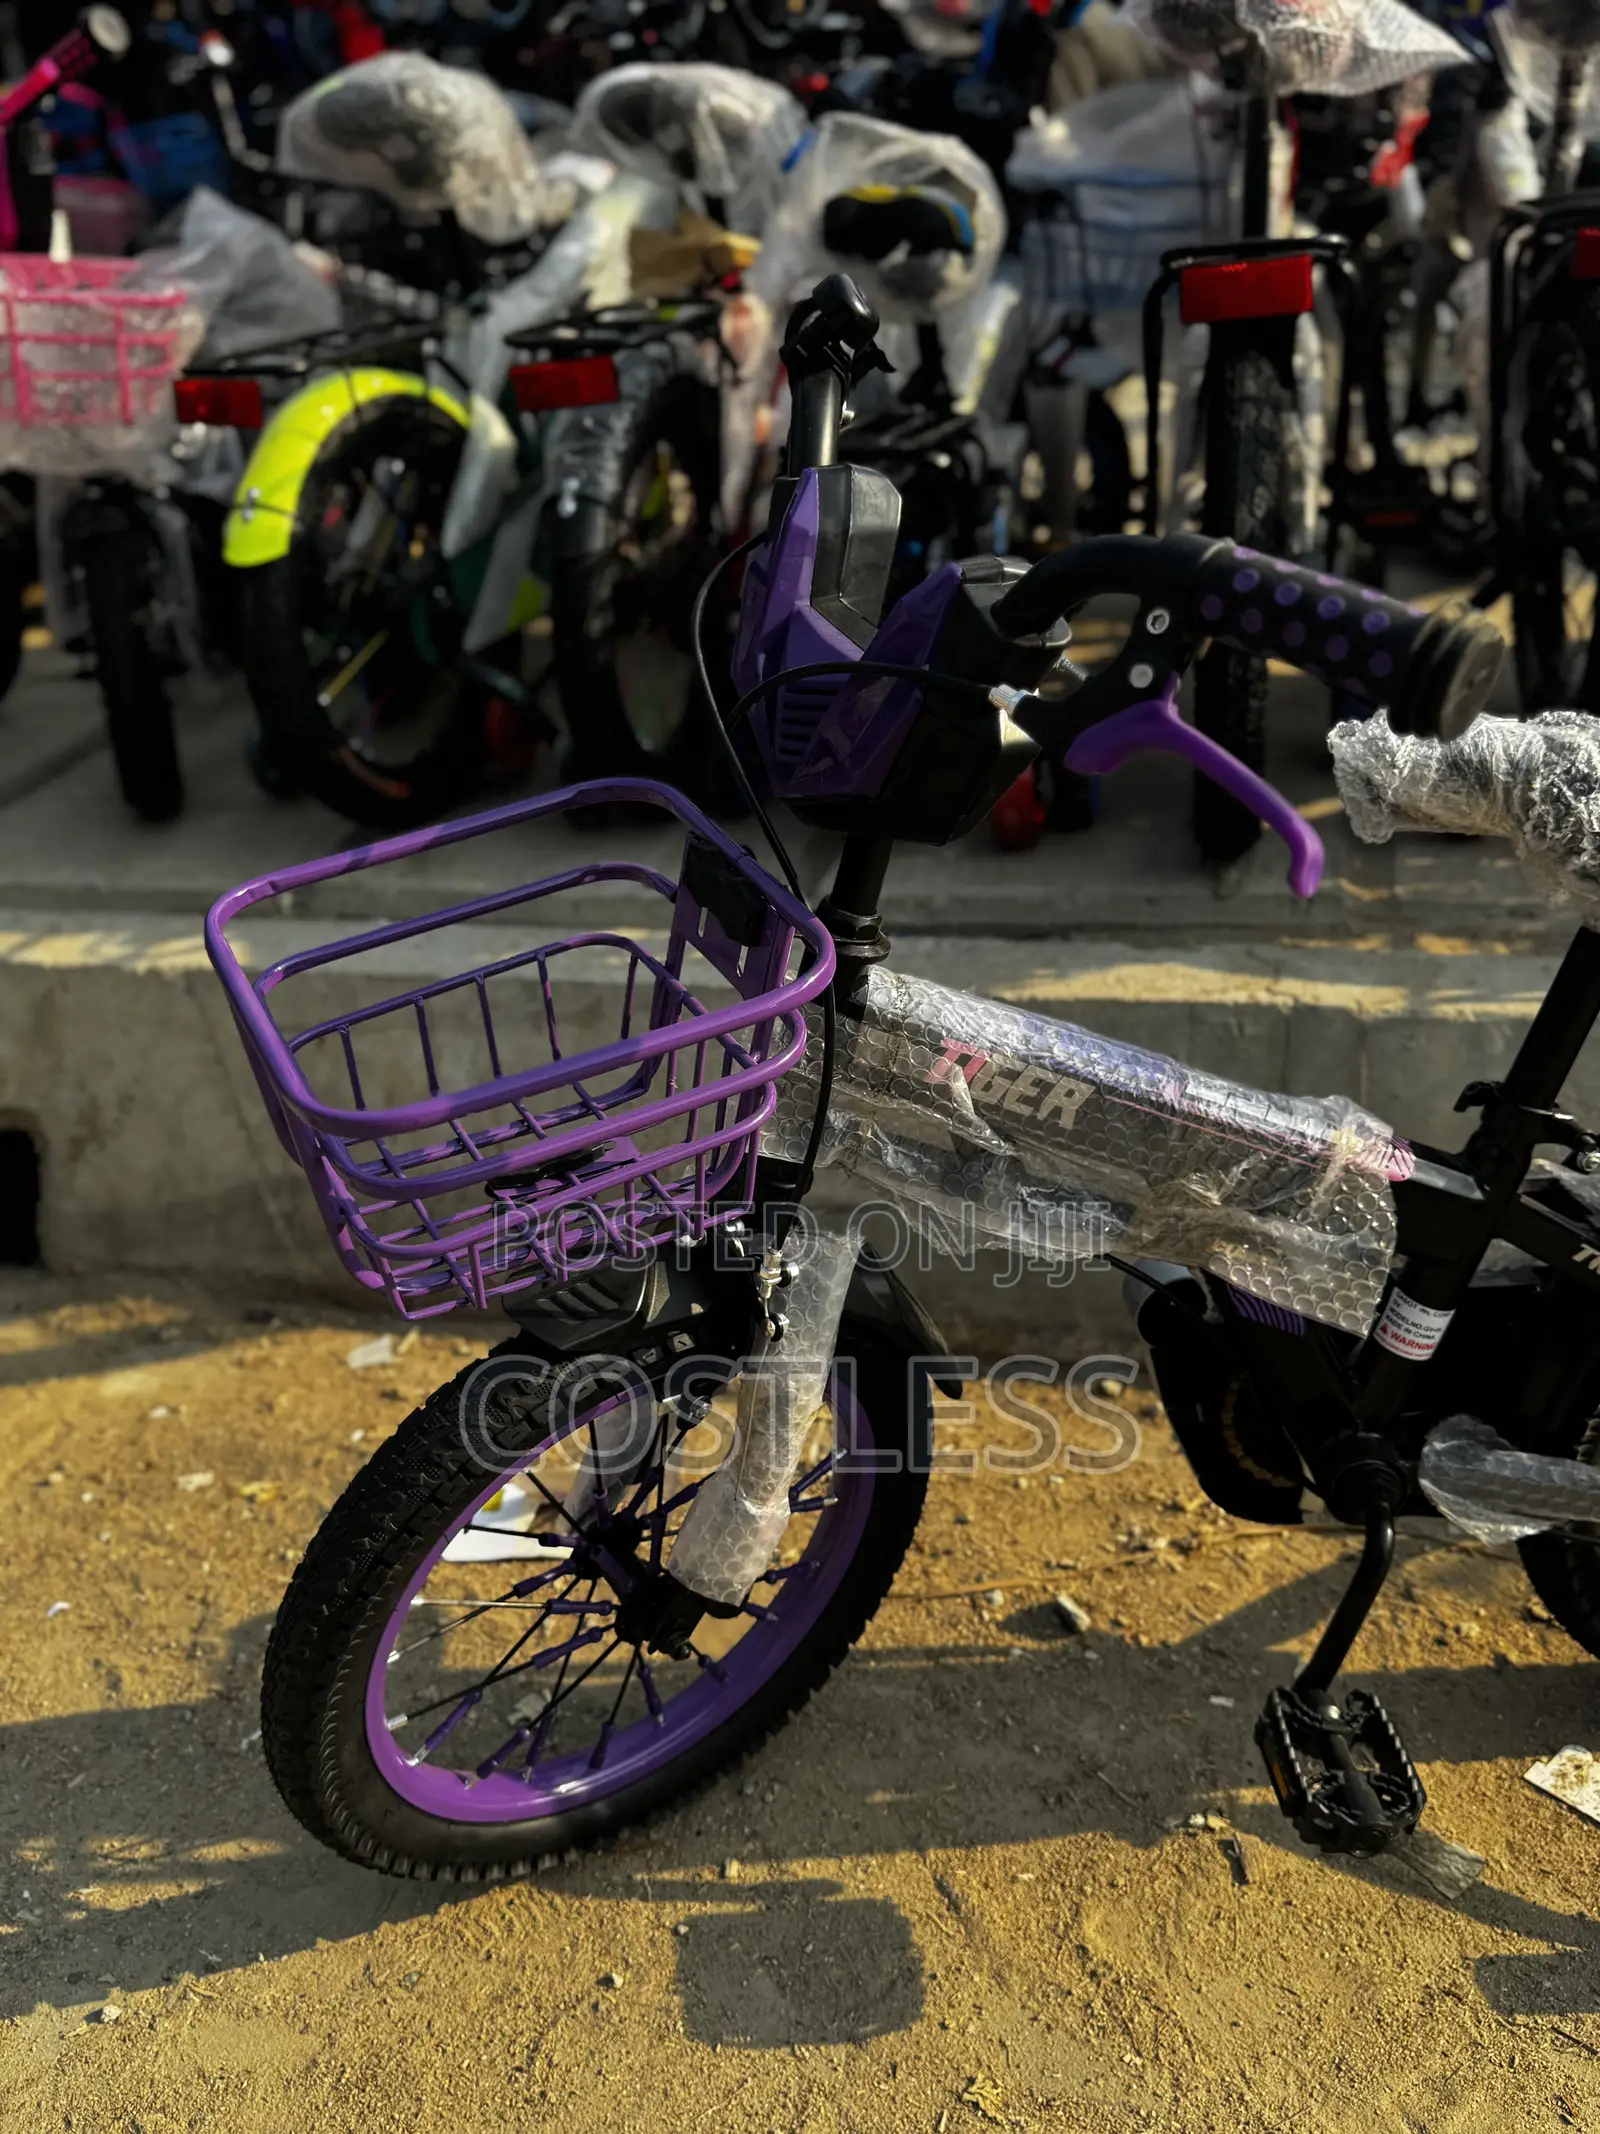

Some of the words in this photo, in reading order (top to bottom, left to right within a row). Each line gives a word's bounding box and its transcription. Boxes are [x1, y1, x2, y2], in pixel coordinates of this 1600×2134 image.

[924, 1037, 1096, 1130] TIGER
[1385, 1313, 1403, 1330] MADE
[1403, 1326, 1412, 1335] IN
